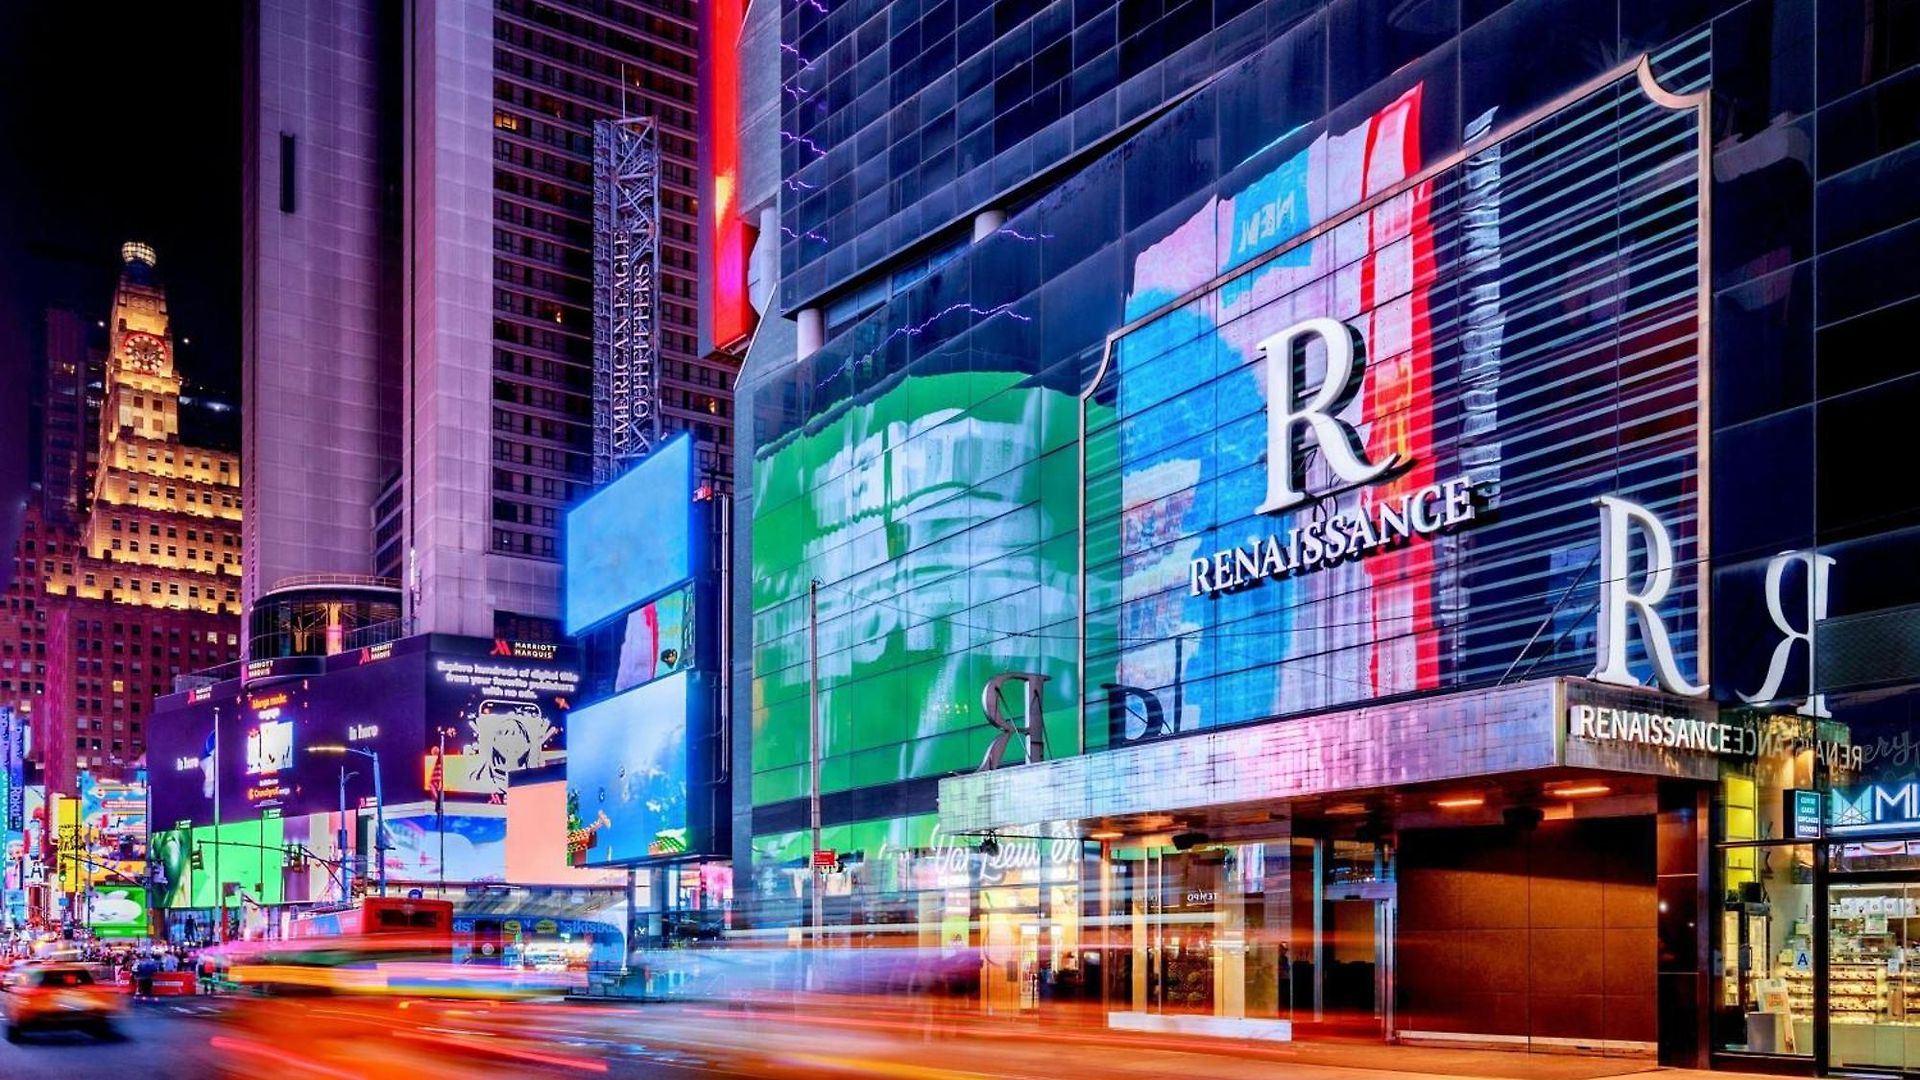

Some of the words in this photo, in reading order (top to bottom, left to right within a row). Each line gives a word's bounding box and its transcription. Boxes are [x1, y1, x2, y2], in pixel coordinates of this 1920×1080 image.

[614, 231, 629, 307] EAGLE
[614, 318, 629, 452] AMERICAN
[633, 264, 649, 418] OUTFITTERS
[1255, 317, 1401, 515] R
[1189, 475, 1476, 597] RENAISSANCE
[1591, 496, 1710, 696] R
[514, 641, 558, 652] MARRIOTT
[514, 649, 554, 659] MARQUIS
[1578, 704, 1731, 753] RENAISSANCE
[1798, 952, 1808, 967] A
